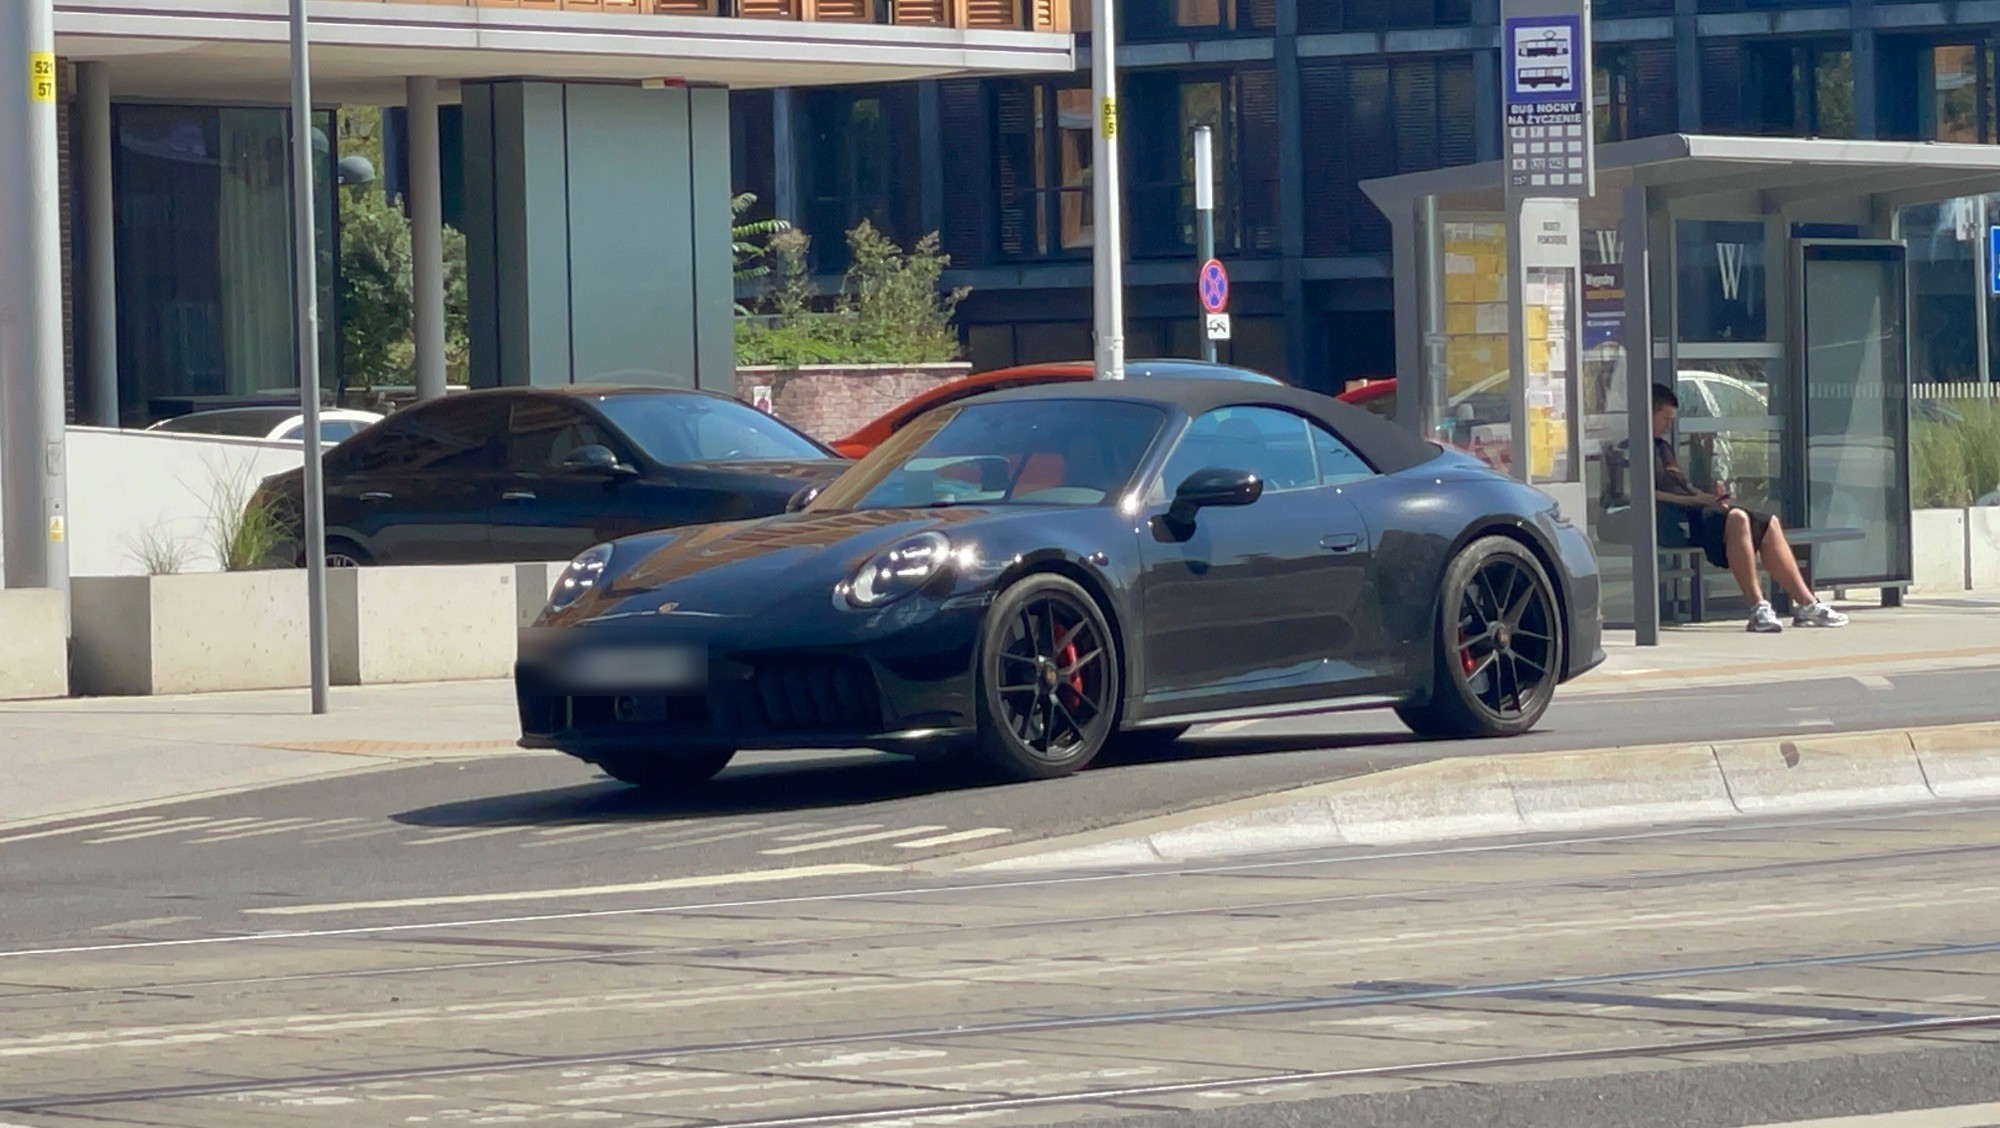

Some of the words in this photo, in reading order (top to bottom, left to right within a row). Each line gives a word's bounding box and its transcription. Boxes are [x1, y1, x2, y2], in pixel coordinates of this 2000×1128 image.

[38, 82, 52, 96] 57
[1511, 104, 1534, 114] BUS
[1537, 102, 1577, 113] NOCNY
[1508, 115, 1525, 125] NA
[1716, 243, 1744, 300] W
